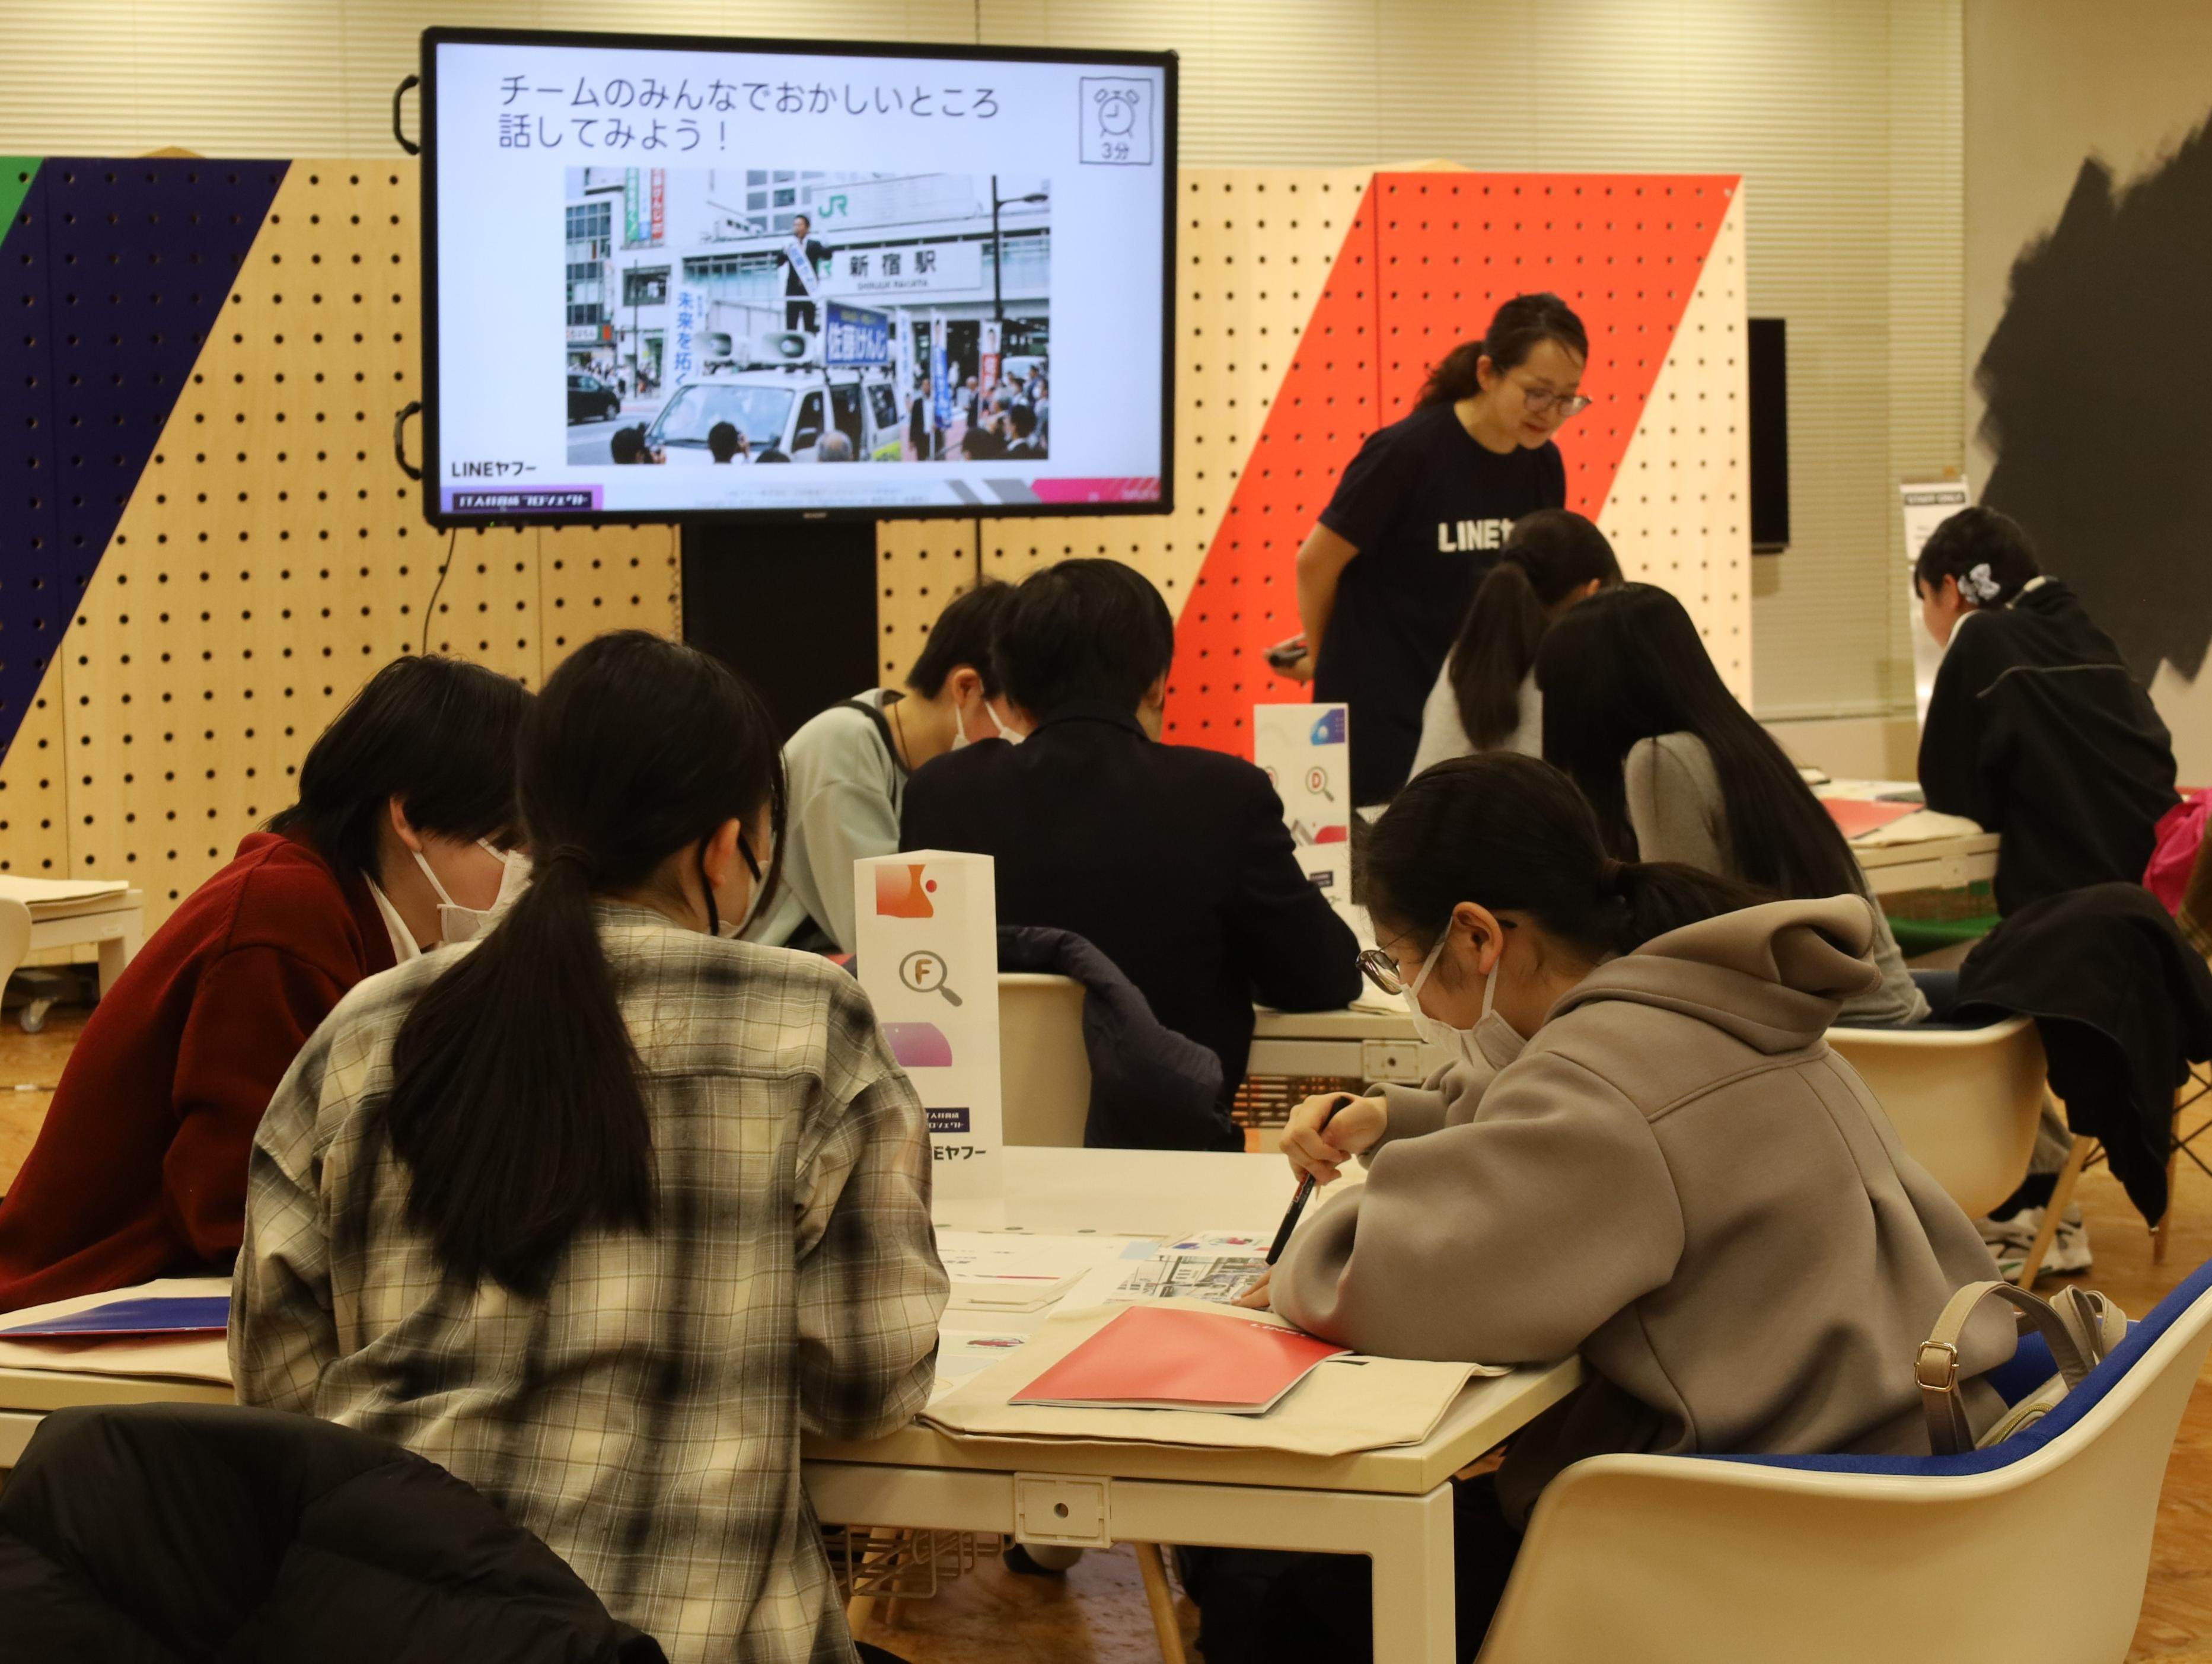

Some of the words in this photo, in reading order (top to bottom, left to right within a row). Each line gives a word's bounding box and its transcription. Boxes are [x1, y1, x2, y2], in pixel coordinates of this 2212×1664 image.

[500, 75, 999, 119] チームのみんなでおかしいところ
[499, 113, 725, 151] 話してみよう！
[1101, 142, 1129, 160] 3分
[818, 195, 848, 218] JR
[850, 250, 936, 278] 新宿駅
[452, 461, 537, 477] LINEヤフー
[1311, 772, 1322, 789] D
[915, 958, 933, 984] F
[933, 1145, 987, 1161] Eヤフー
